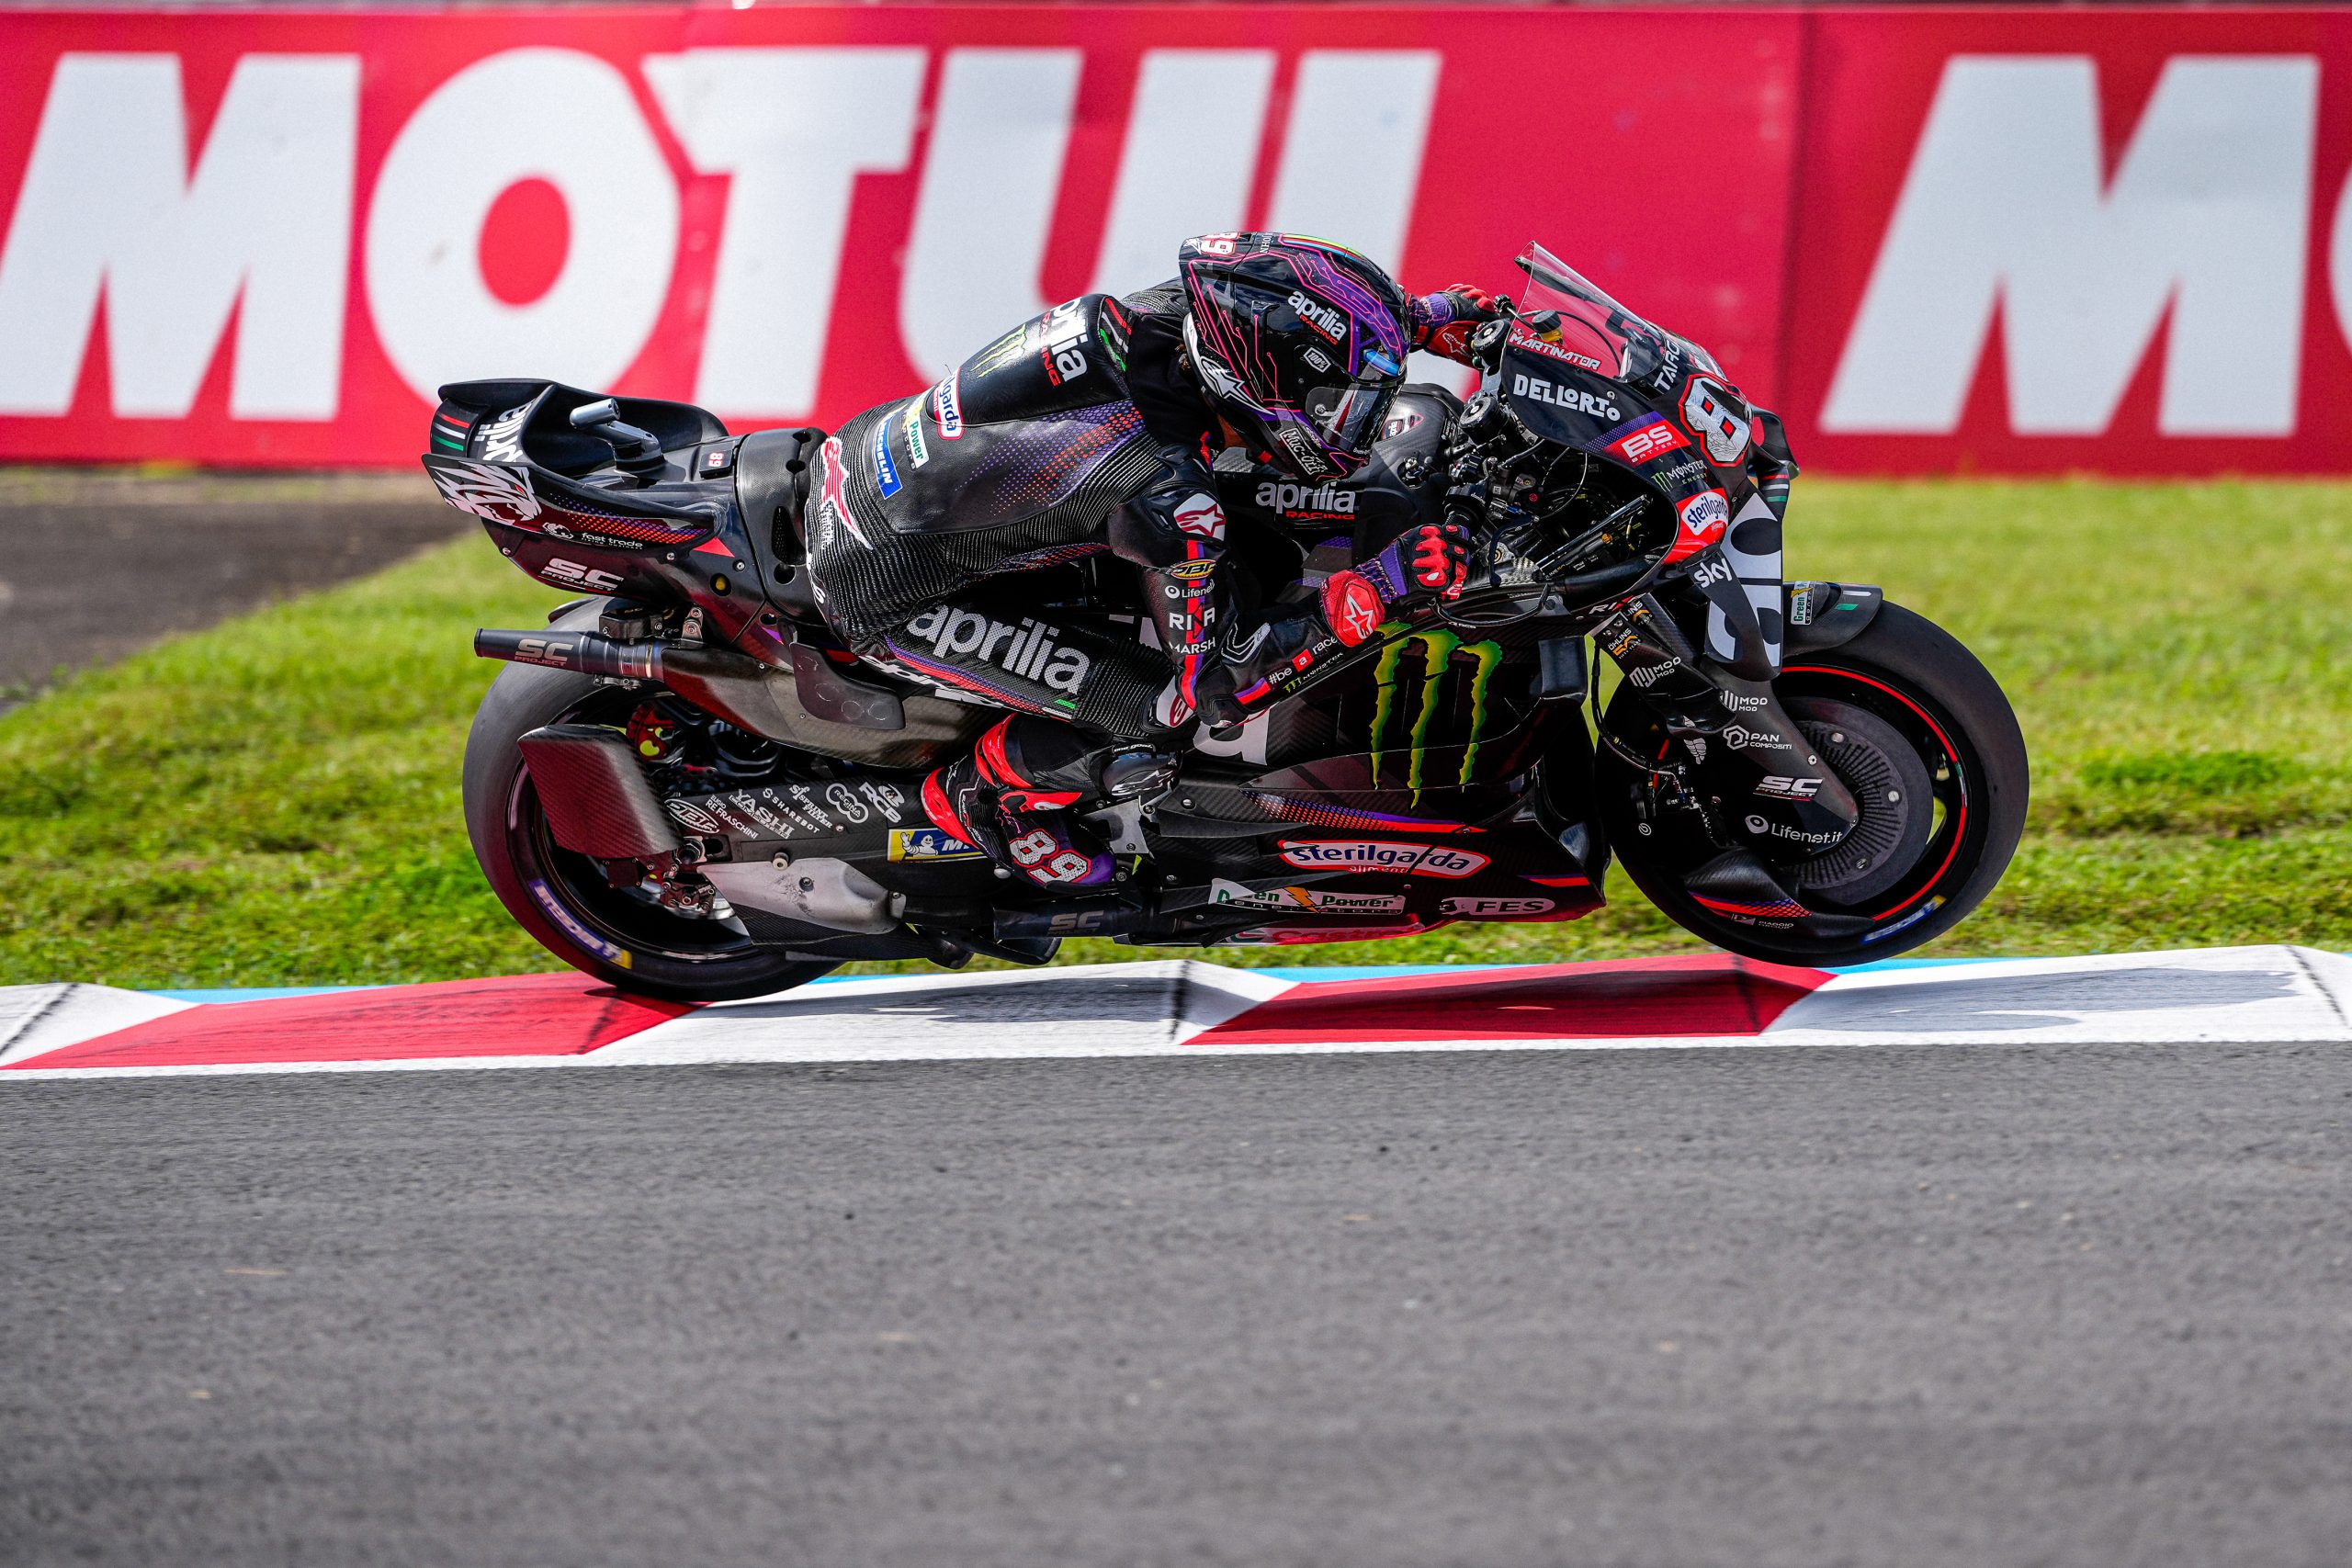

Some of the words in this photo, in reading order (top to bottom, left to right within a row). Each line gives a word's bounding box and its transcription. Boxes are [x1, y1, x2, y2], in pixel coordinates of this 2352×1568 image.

[1819, 54, 2352, 435] M
[1287, 290, 1347, 341] aprilia
[1299, 314, 1339, 345] RACING
[1307, 352, 1327, 369] 100%
[1510, 333, 1601, 369] MARTINATOR
[909, 421, 924, 460] Power
[1621, 424, 1673, 458] BS
[1631, 440, 1678, 463] BATTERY
[1667, 459, 1707, 479] MONSTER
[1256, 481, 1356, 513] aprilia
[1286, 511, 1355, 520] RACING
[582, 533, 605, 542] fast
[608, 537, 643, 547] trade
[543, 558, 625, 588] SC
[1694, 558, 1733, 588] sky
[1793, 597, 1805, 622] Green
[514, 638, 574, 661] SC
[907, 604, 1090, 694] aprilia
[1169, 637, 1216, 655] MARSH
[1608, 627, 1632, 651] ÖHLINS
[514, 655, 567, 668] PROJECT
[1655, 656, 1681, 672] MOD
[1656, 668, 1675, 679] MOD
[1269, 668, 1293, 685] #be
[1738, 697, 1769, 705] MOD
[1750, 732, 1780, 742] PAN
[1755, 787, 1815, 797] PROJECT
[1758, 775, 1823, 793] SC
[736, 788, 796, 838] YASHI
[798, 794, 829, 819] SPRINT
[834, 788, 862, 818] REGINA
[859, 782, 902, 823] RCB
[705, 800, 718, 814] RE
[715, 807, 760, 840] FRASCHINI
[771, 796, 820, 834] SHAREBOT
[803, 805, 833, 829] FILTER
[1771, 821, 1843, 844] Lifenet.it
[1009, 829, 1090, 884] 89
[1293, 844, 1470, 870] sterilgarda
[1322, 895, 1394, 908] Power
[1476, 900, 1544, 913] FES
[1048, 910, 1104, 931] SC
